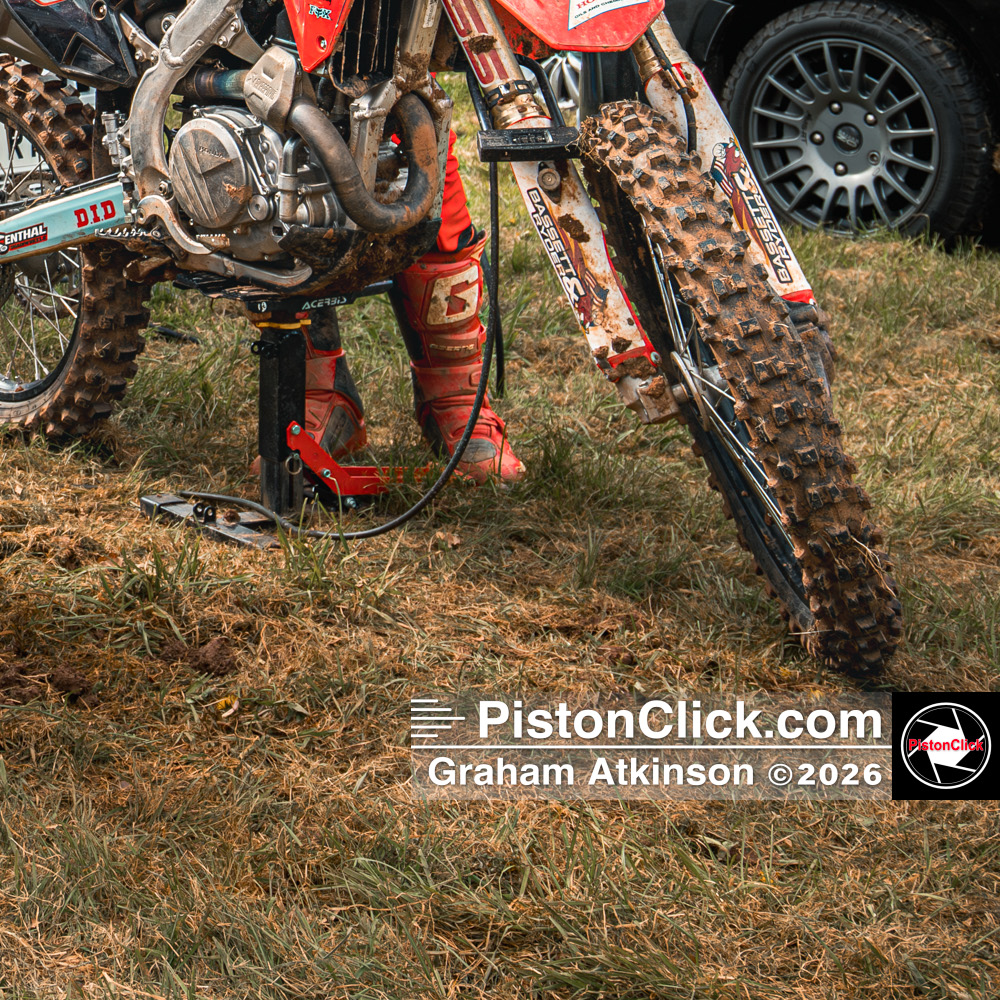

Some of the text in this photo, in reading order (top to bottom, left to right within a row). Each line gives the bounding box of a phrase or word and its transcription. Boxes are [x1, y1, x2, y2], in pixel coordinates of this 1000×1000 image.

[574, 10, 588, 19] OILS
[587, 3, 600, 13] AND
[74, 199, 116, 228] D.I.D
[529, 189, 577, 277] BASSETT
[532, 213, 566, 277] RYDER
[744, 193, 791, 282] BASSETT
[756, 193, 790, 260] RYDER
[301, 296, 348, 311] ACERBIS
